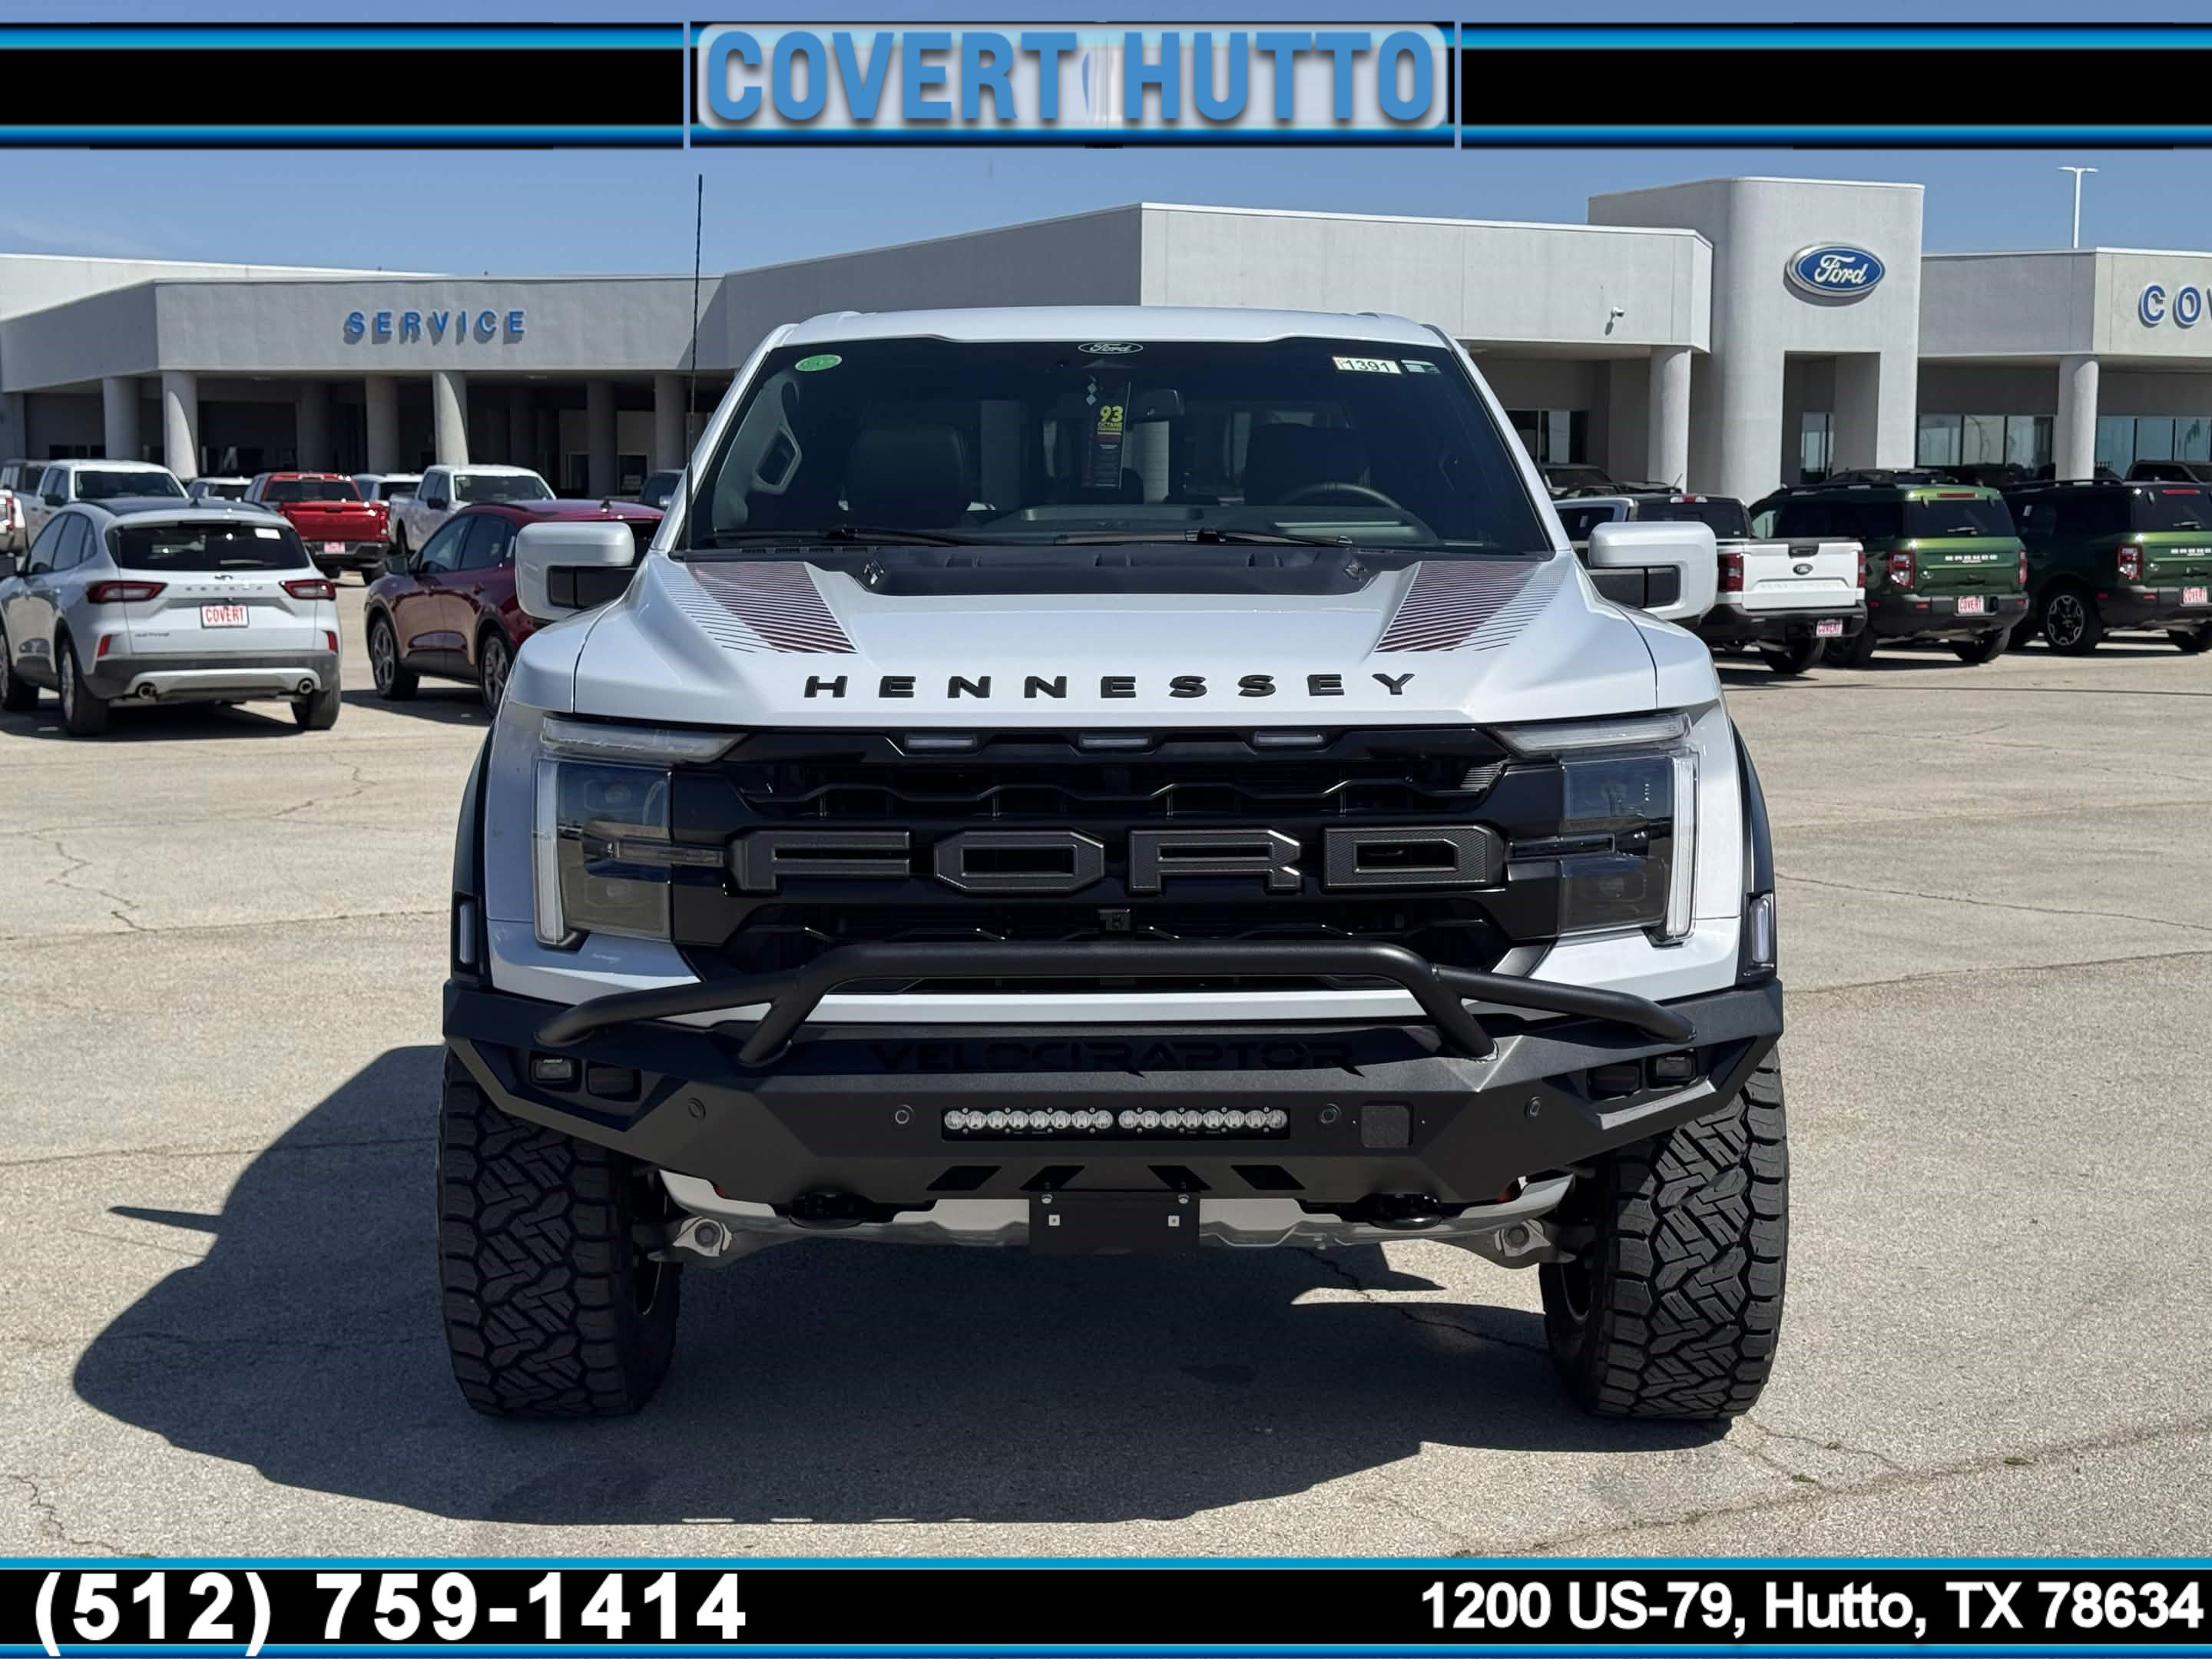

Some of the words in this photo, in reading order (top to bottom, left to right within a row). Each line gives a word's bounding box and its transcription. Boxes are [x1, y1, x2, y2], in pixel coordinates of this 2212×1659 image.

[1814, 254, 1869, 283] Ford
[2140, 283, 2212, 326] CO
[346, 309, 525, 335] SERVICE
[1099, 406, 1123, 422] 93
[205, 608, 243, 623] COVERT
[804, 673, 1415, 698] HENNESSEY
[730, 825, 1503, 892] FORD
[870, 1041, 1366, 1078] VELOCIRAPTOR
